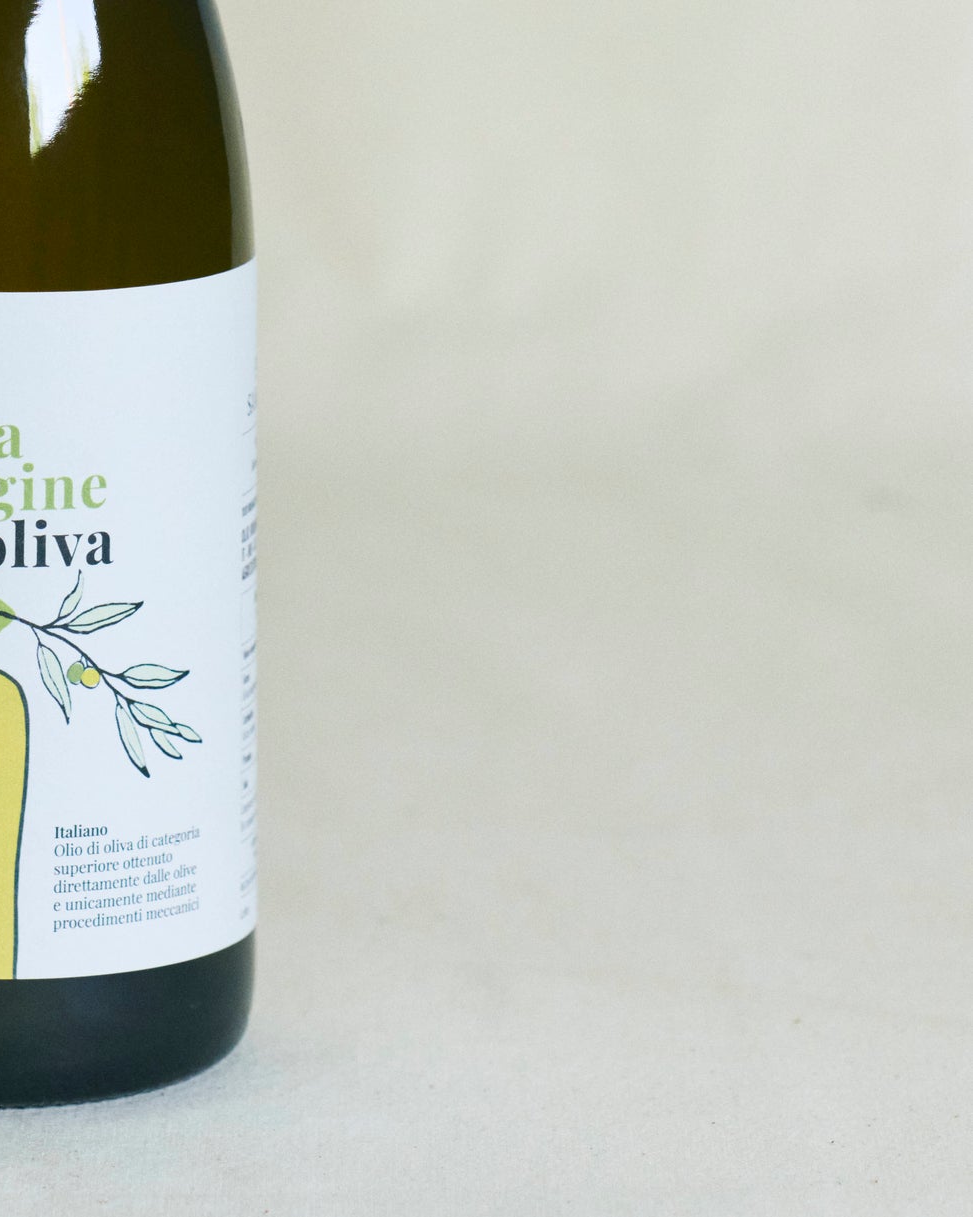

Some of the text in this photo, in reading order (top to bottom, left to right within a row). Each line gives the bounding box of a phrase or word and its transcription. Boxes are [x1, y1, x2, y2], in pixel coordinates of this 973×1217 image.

[54, 825, 108, 839] Italiano
[54, 826, 201, 858] Olio di oliva di categoria
[54, 852, 173, 877] superiore ottenuto
[54, 864, 197, 894] direttamente dalle olive
[54, 882, 197, 912] e unicamente mediante
[53, 897, 200, 933] procedimenti meccanici
